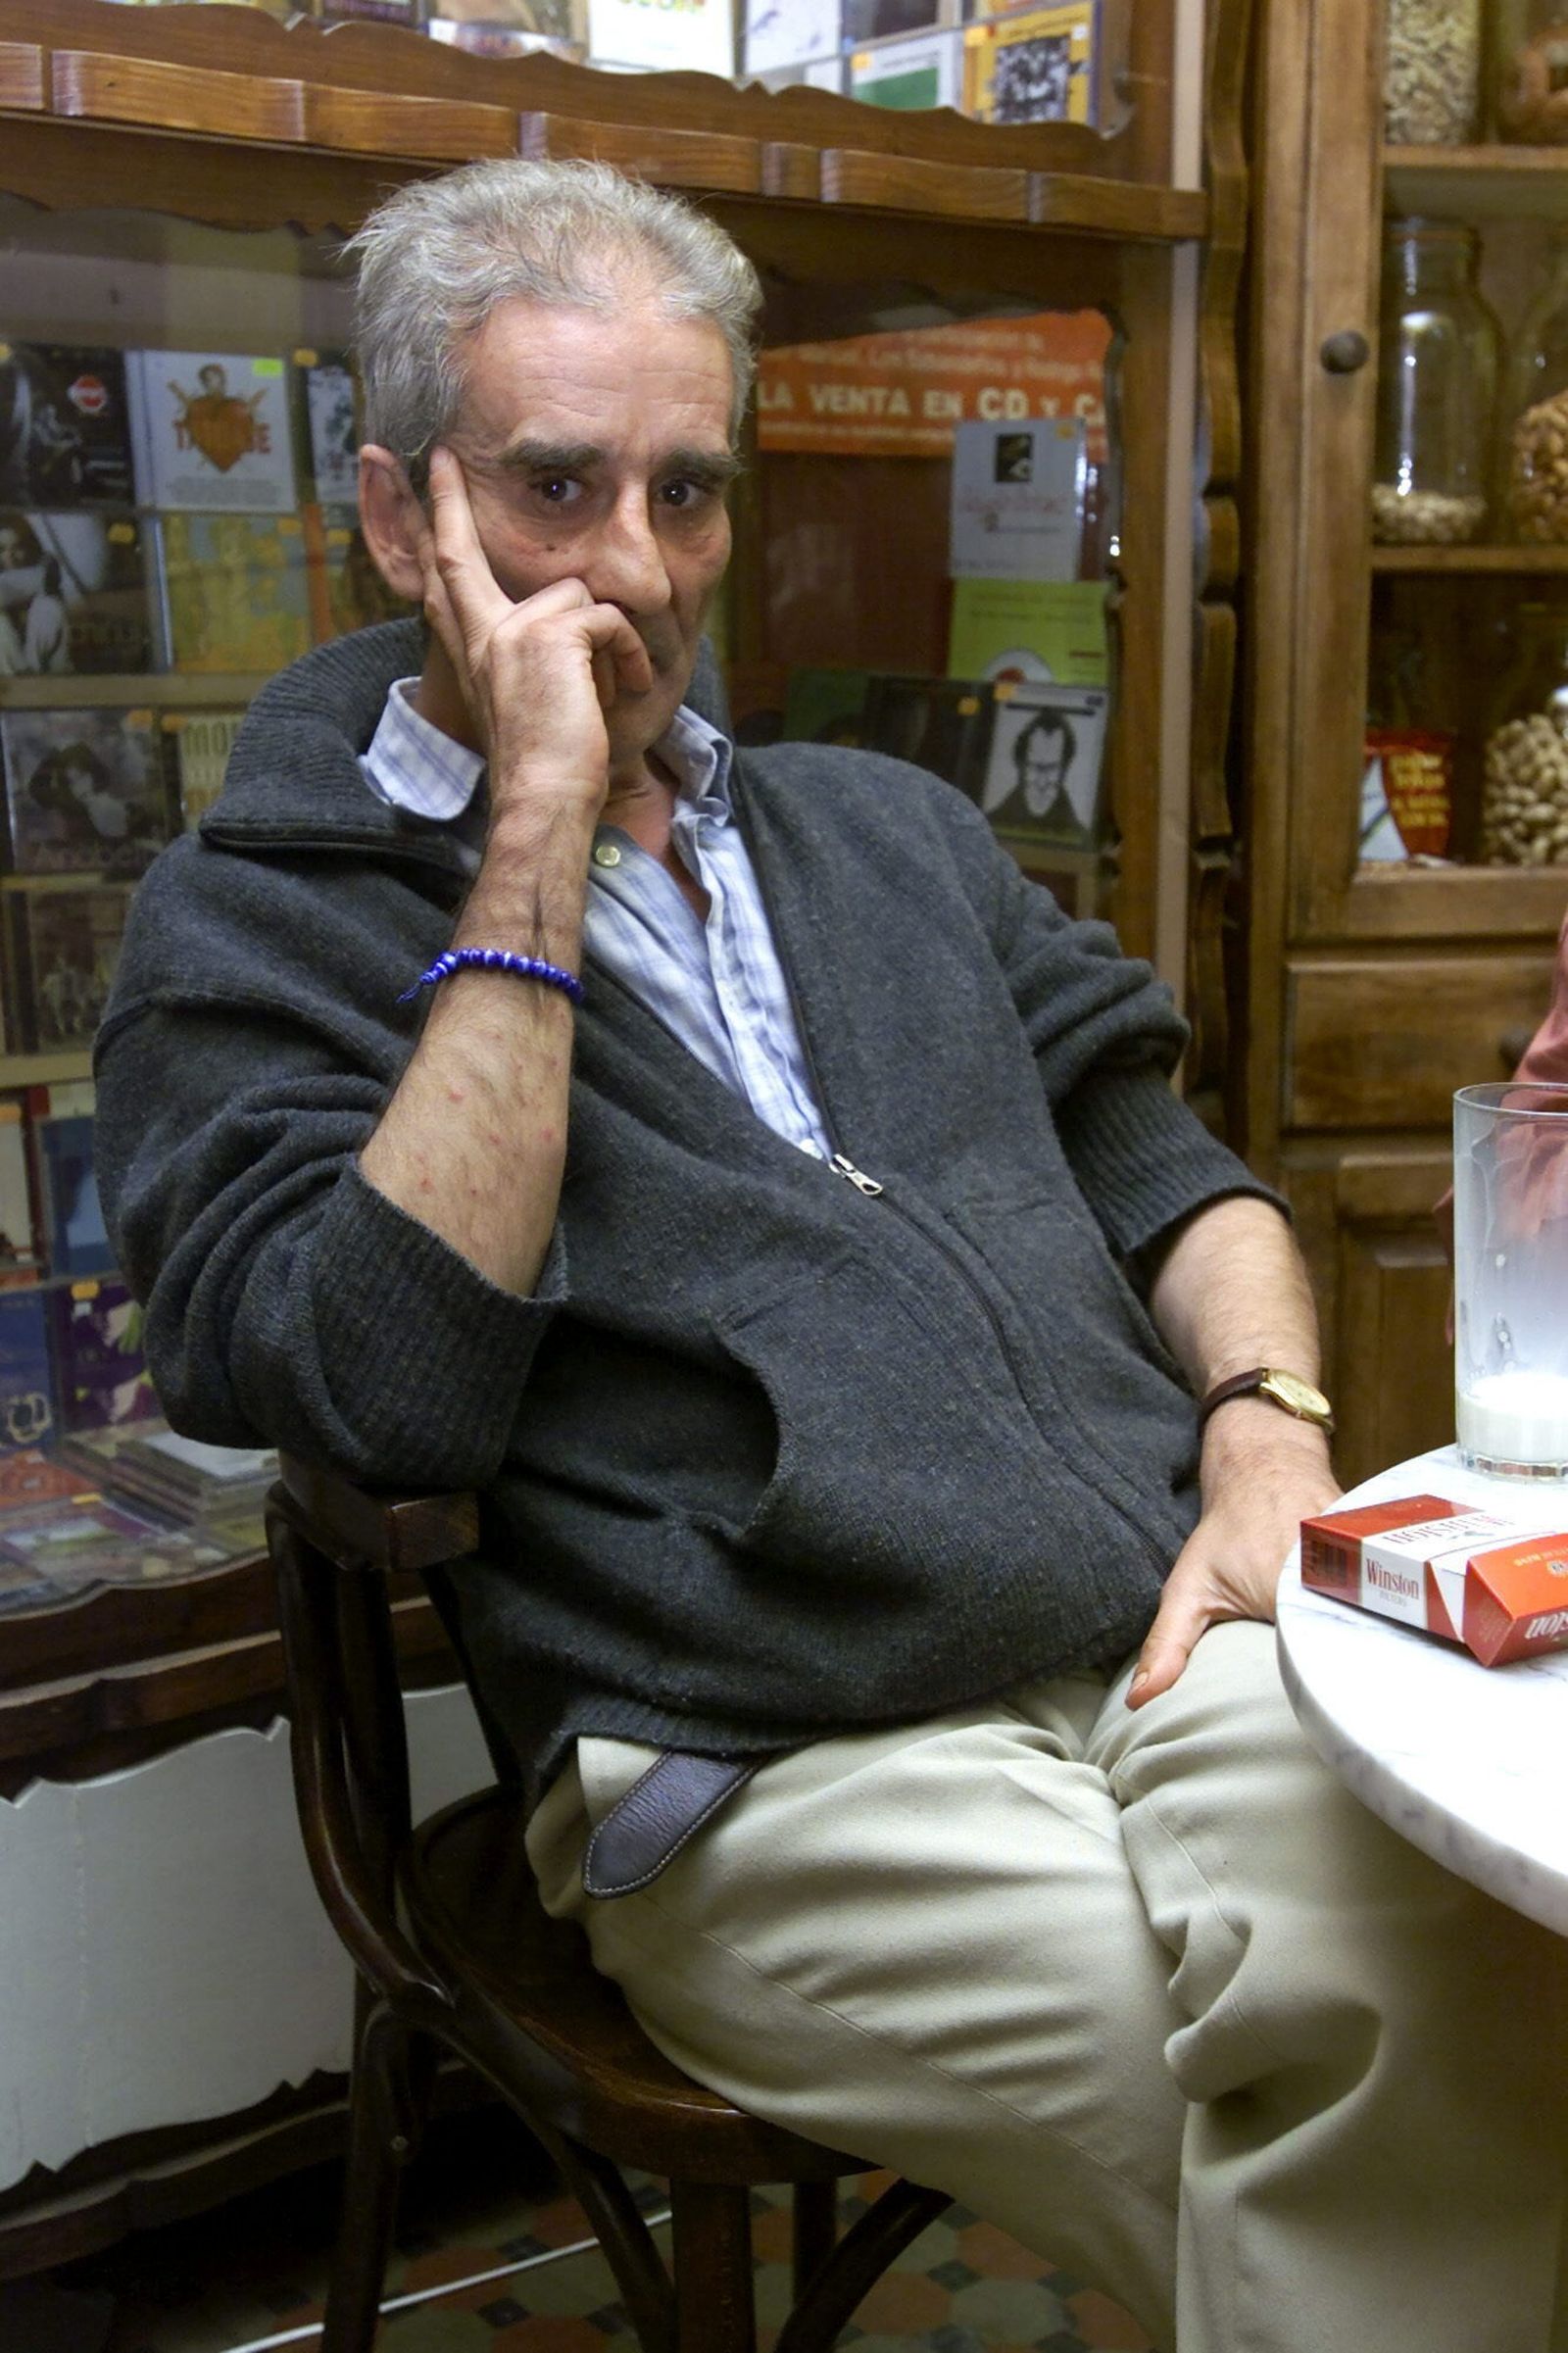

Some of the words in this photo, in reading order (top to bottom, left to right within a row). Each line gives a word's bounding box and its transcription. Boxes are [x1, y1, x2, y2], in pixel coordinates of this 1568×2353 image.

[758, 381, 793, 409] LA
[809, 385, 910, 416] VENTA
[925, 389, 962, 419] EN
[977, 387, 1028, 419] CD
[1367, 1558, 1419, 1599] Winston
